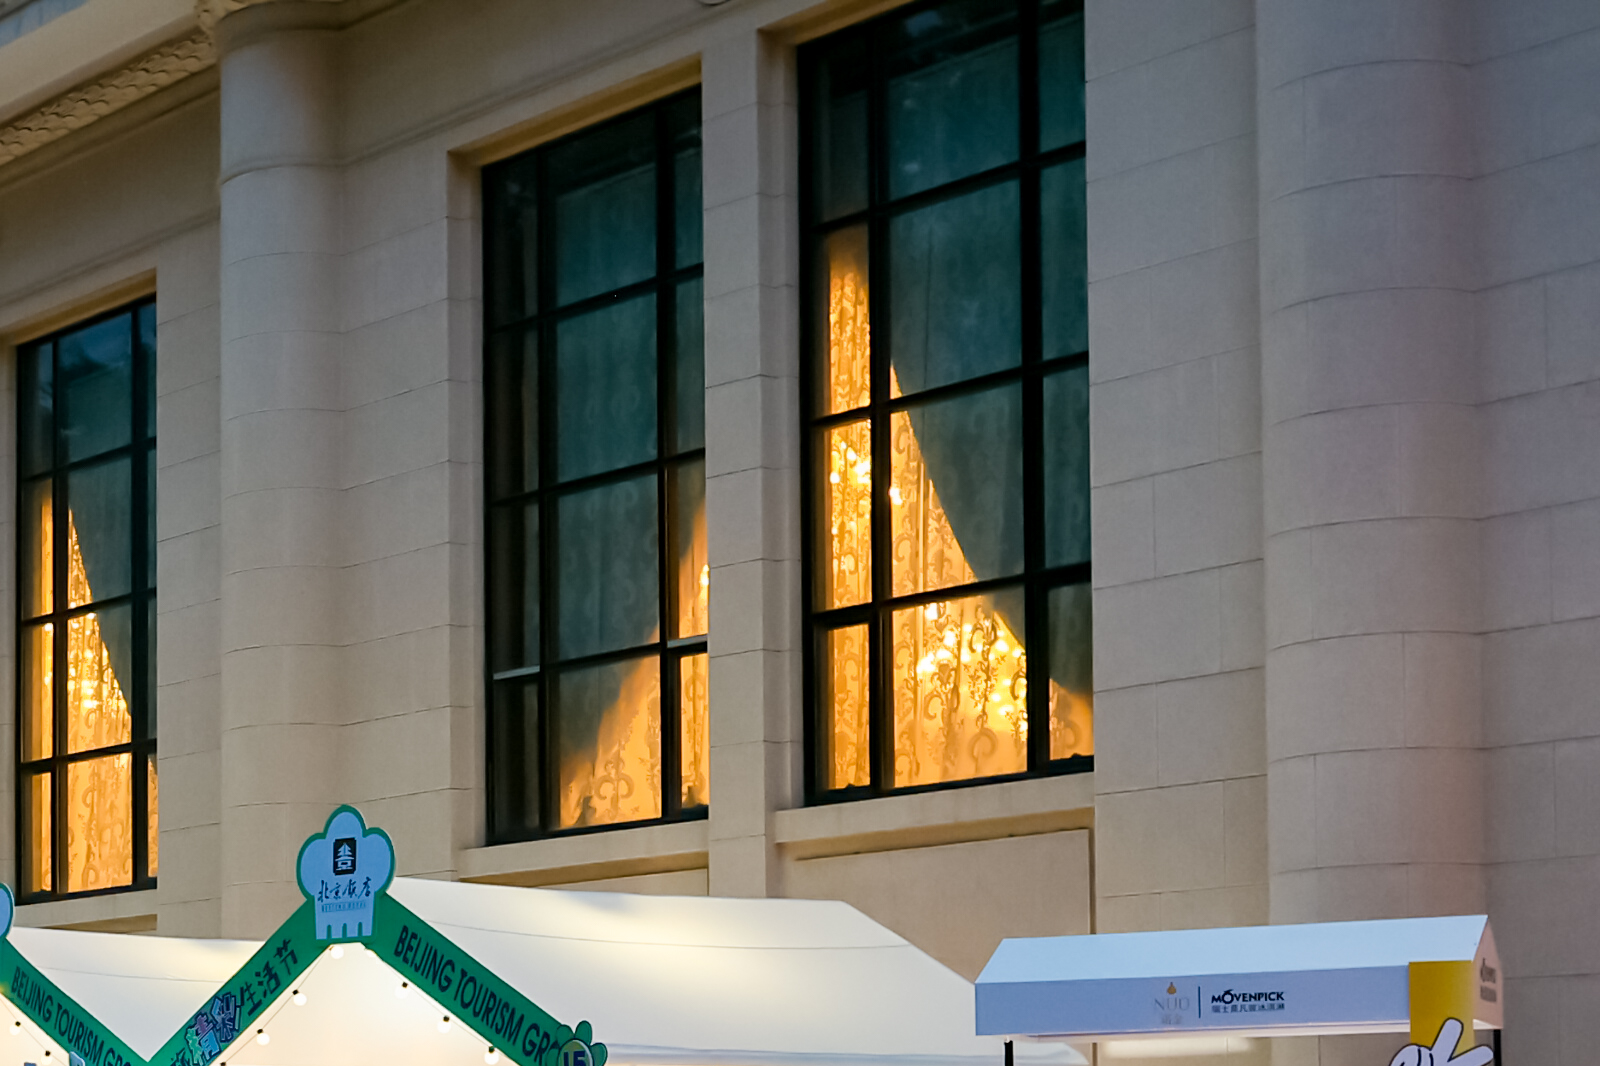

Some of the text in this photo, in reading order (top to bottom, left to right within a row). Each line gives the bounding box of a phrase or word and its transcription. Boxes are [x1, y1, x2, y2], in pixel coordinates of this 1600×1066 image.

[11, 966, 54, 1022] BEIJING
[394, 925, 455, 993] BEIJING
[454, 968, 524, 1046] TOURISM
